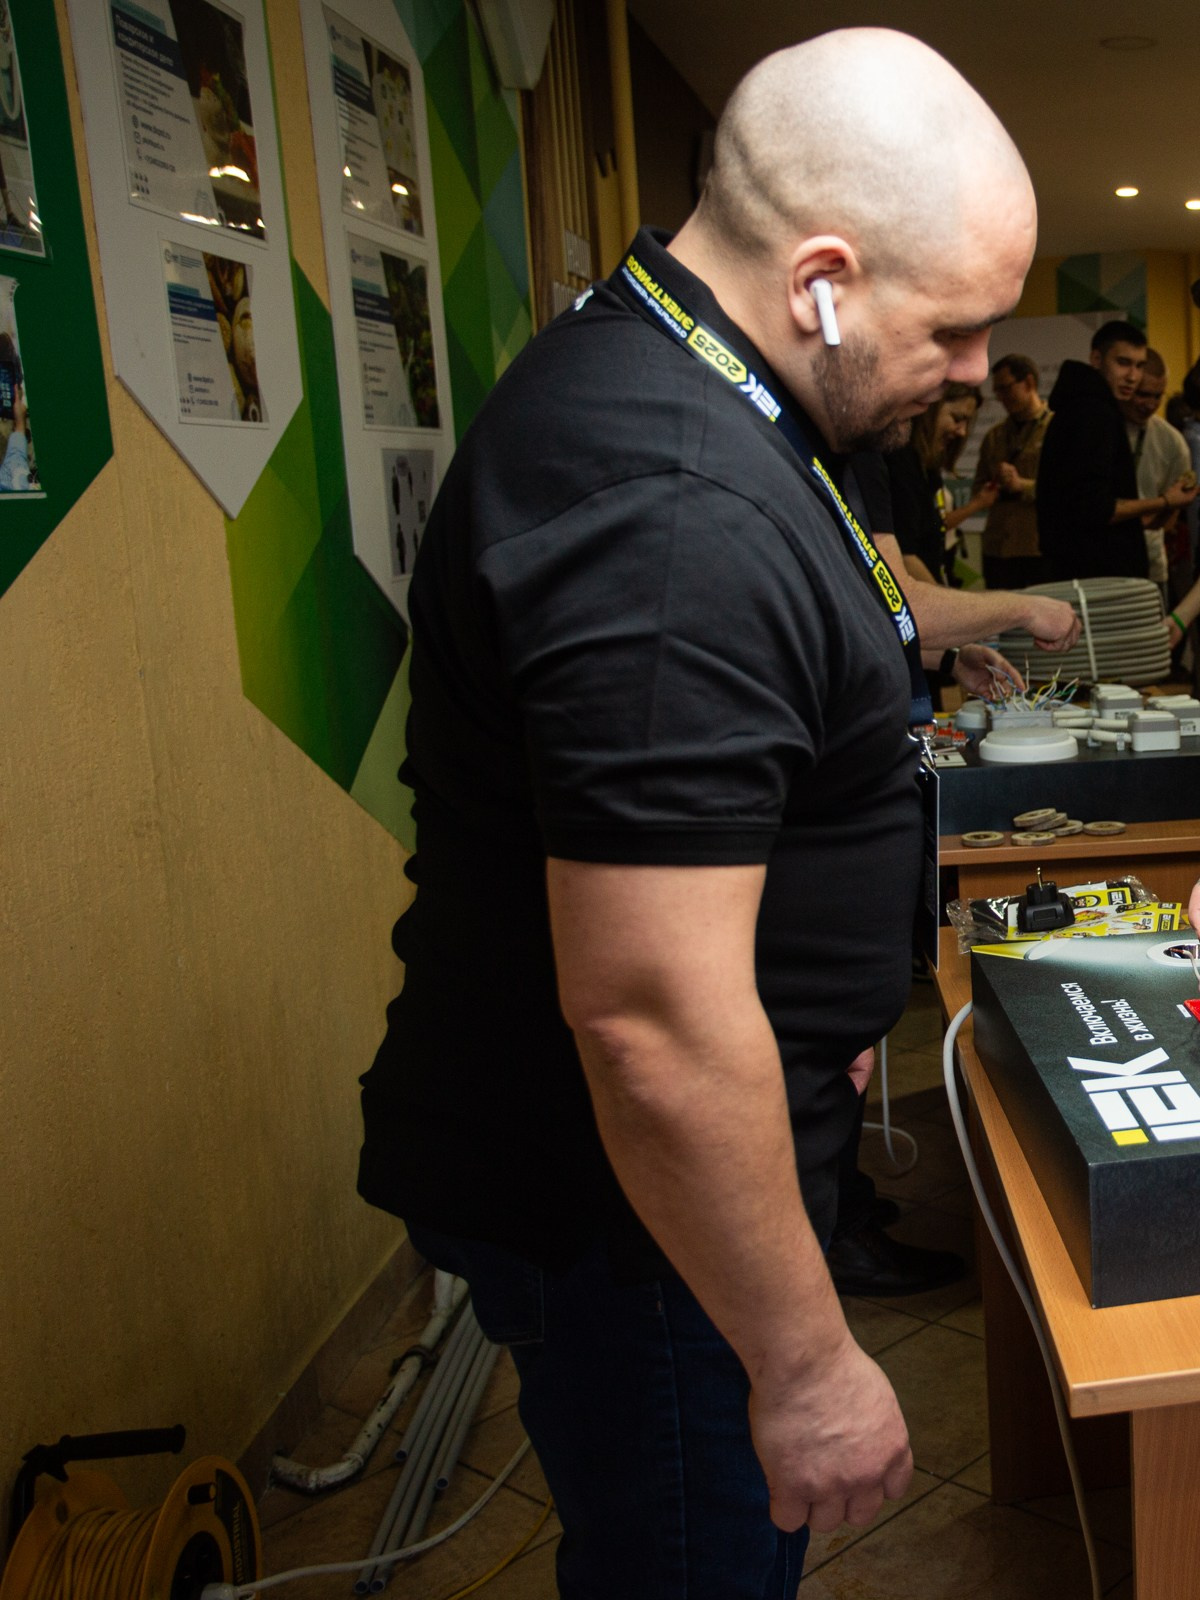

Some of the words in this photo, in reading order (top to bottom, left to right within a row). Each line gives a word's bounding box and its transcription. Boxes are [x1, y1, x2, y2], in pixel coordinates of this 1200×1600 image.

[626, 254, 695, 332] ЭЛЕКТРИКОВ
[646, 297, 688, 339] ОТКРЫТЫЙ
[693, 333, 742, 377] 2025
[812, 456, 879, 562] ЭЛЕКТРИКОВ
[876, 566, 900, 607] 2025
[1060, 982, 1119, 1046] Включаемся
[1100, 998, 1150, 1034] жизнь!
[1134, 1032, 1155, 1041] в
[232, 1499, 245, 1586] INDUSTRIAL
